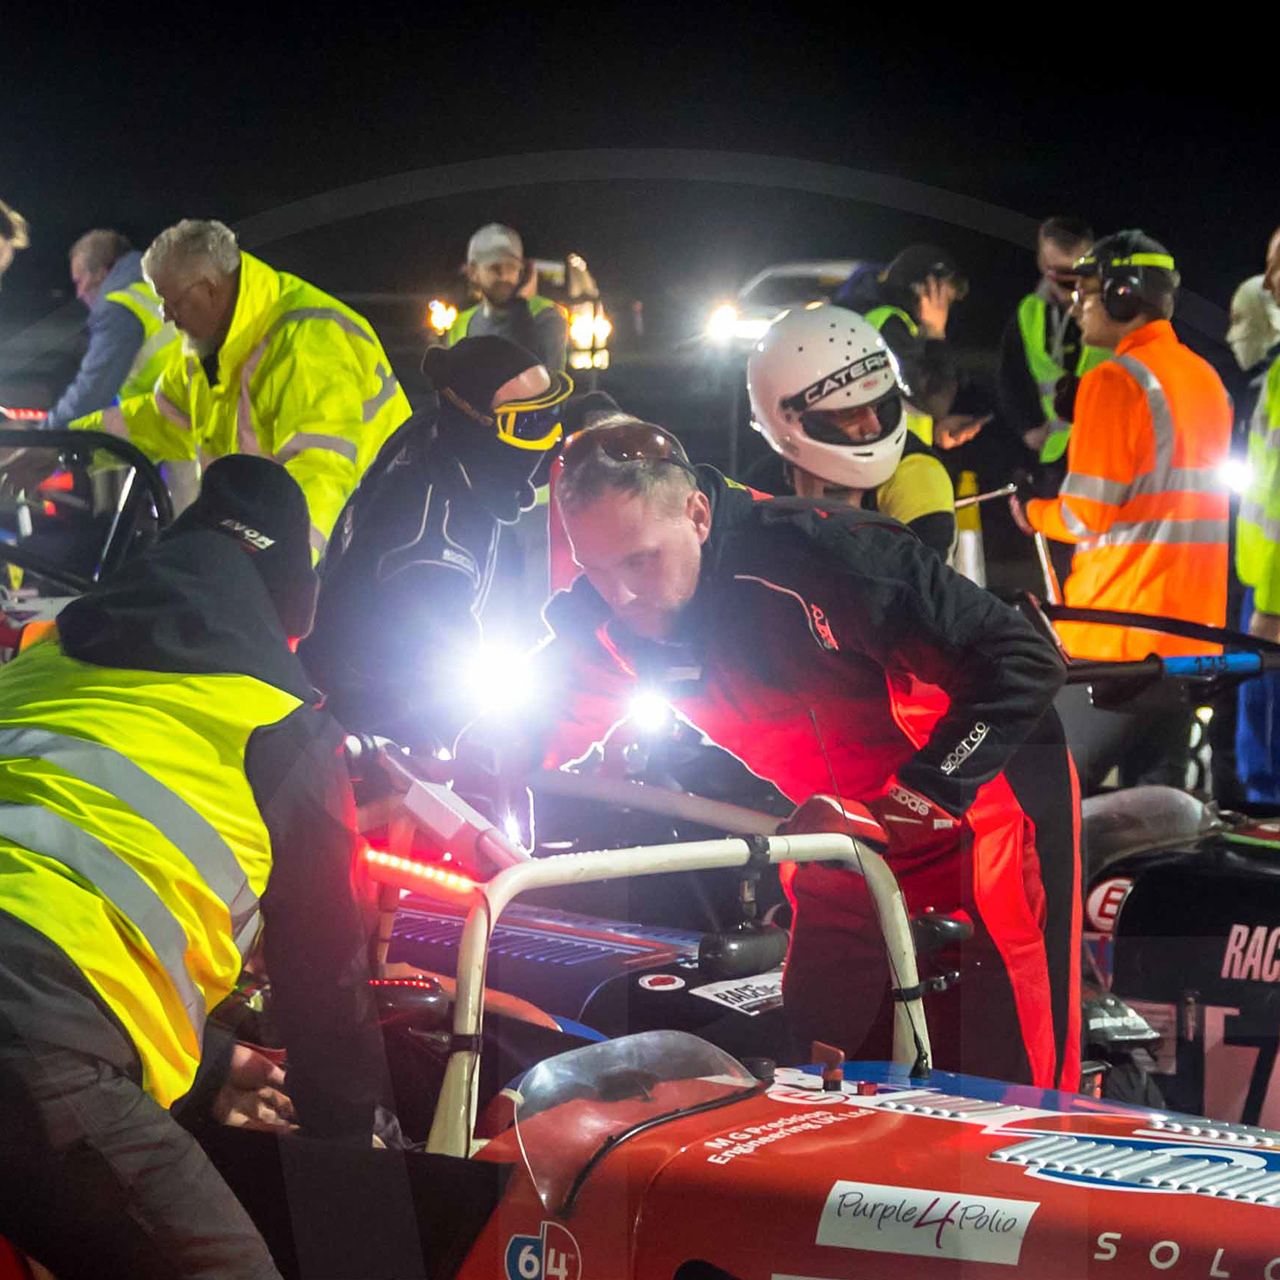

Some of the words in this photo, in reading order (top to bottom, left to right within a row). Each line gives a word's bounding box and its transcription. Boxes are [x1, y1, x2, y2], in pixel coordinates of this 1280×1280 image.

[940, 721, 988, 774] sparco
[707, 1120, 822, 1165] Engineering
[745, 1109, 834, 1135] Precision
[836, 1190, 919, 1231] Purple
[912, 1197, 961, 1249] 4
[958, 1204, 1018, 1234] Polio
